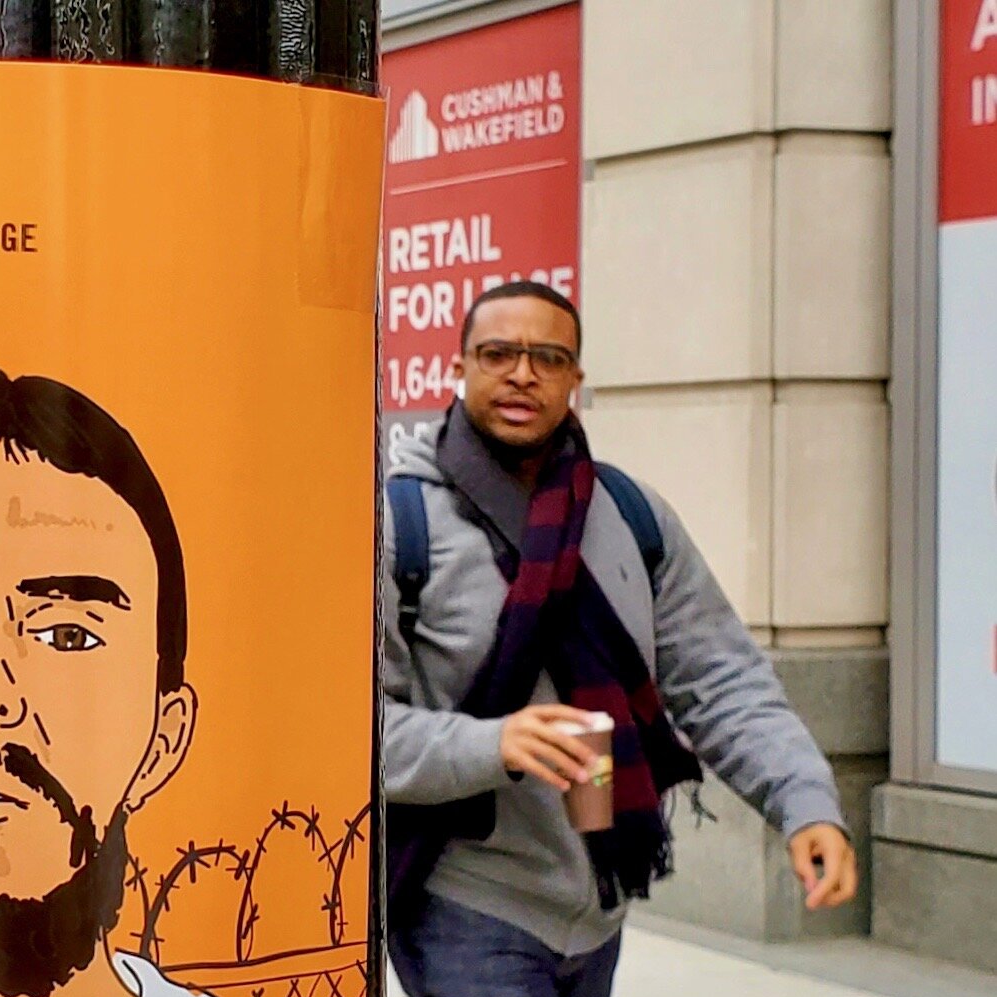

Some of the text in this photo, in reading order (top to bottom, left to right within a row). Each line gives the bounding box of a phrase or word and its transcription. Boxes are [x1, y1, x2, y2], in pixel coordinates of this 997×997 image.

[441, 70, 563, 122] CUSHMAN &
[442, 104, 565, 153] WAKEFIELD
[388, 214, 501, 274] RETAIL
[389, 282, 454, 332] FOR
